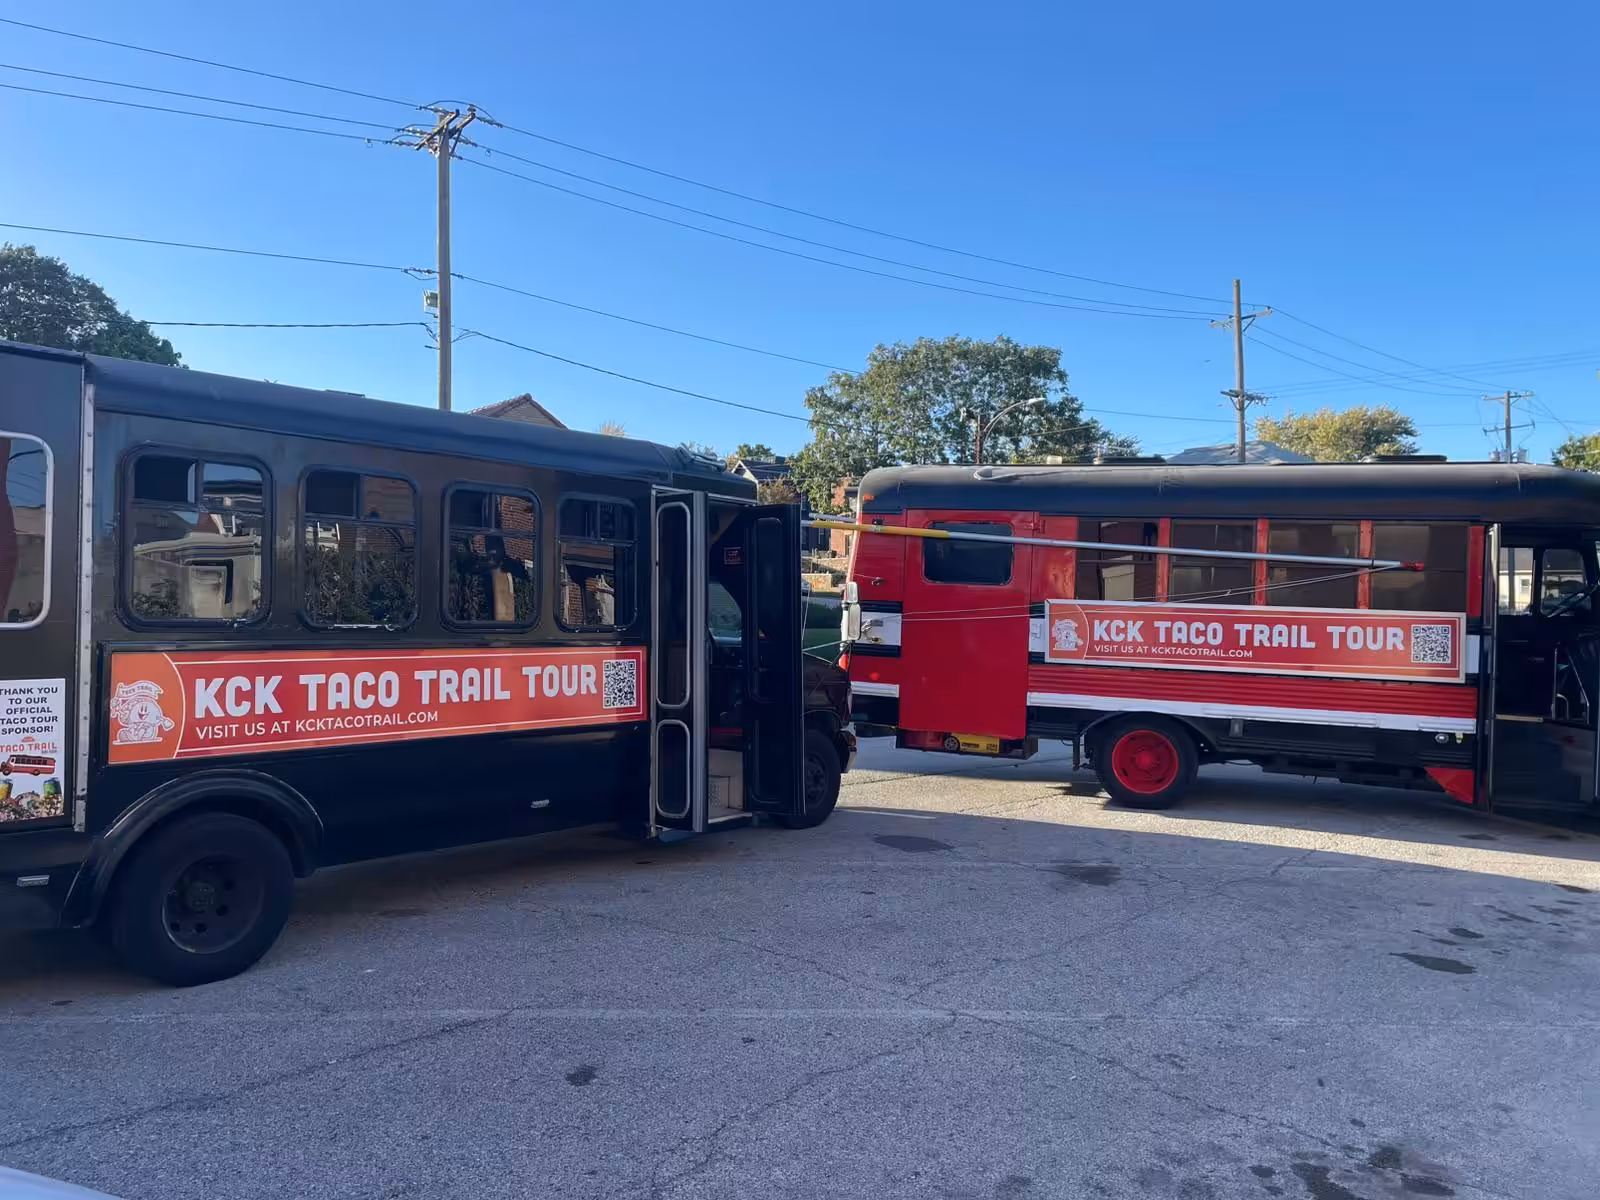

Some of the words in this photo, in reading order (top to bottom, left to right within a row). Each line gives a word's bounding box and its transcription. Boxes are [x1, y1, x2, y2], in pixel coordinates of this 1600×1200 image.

[1093, 619, 1144, 643] KCK
[1154, 621, 1223, 646] TACO
[1233, 623, 1316, 649] TRAIL
[1326, 625, 1405, 651] TOUR
[1094, 645, 1118, 653] VISIT
[1121, 645, 1134, 654] US
[1136, 646, 1149, 654] AT
[1151, 647, 1253, 658] KCKTACOTRAIL.COM
[37, 686, 58, 694] YOU
[194, 675, 283, 719] KCK
[299, 670, 400, 712] TACO
[414, 667, 511, 705] TRAIL
[522, 664, 598, 698] TOUR
[8, 697, 22, 705] TO
[25, 696, 48, 704] OUR
[5, 706, 52, 715] OFFICIAL
[0, 717, 27, 725] TACO
[30, 715, 58, 723] TOUR
[1, 725, 54, 735] SPONSOR!
[196, 724, 240, 740] VISIT
[244, 722, 266, 736] US
[270, 720, 291, 735] AT
[295, 711, 439, 732] KCKTACOTRAIL.COM
[0, 743, 25, 752] TACO
[28, 742, 57, 751] TRAIL
